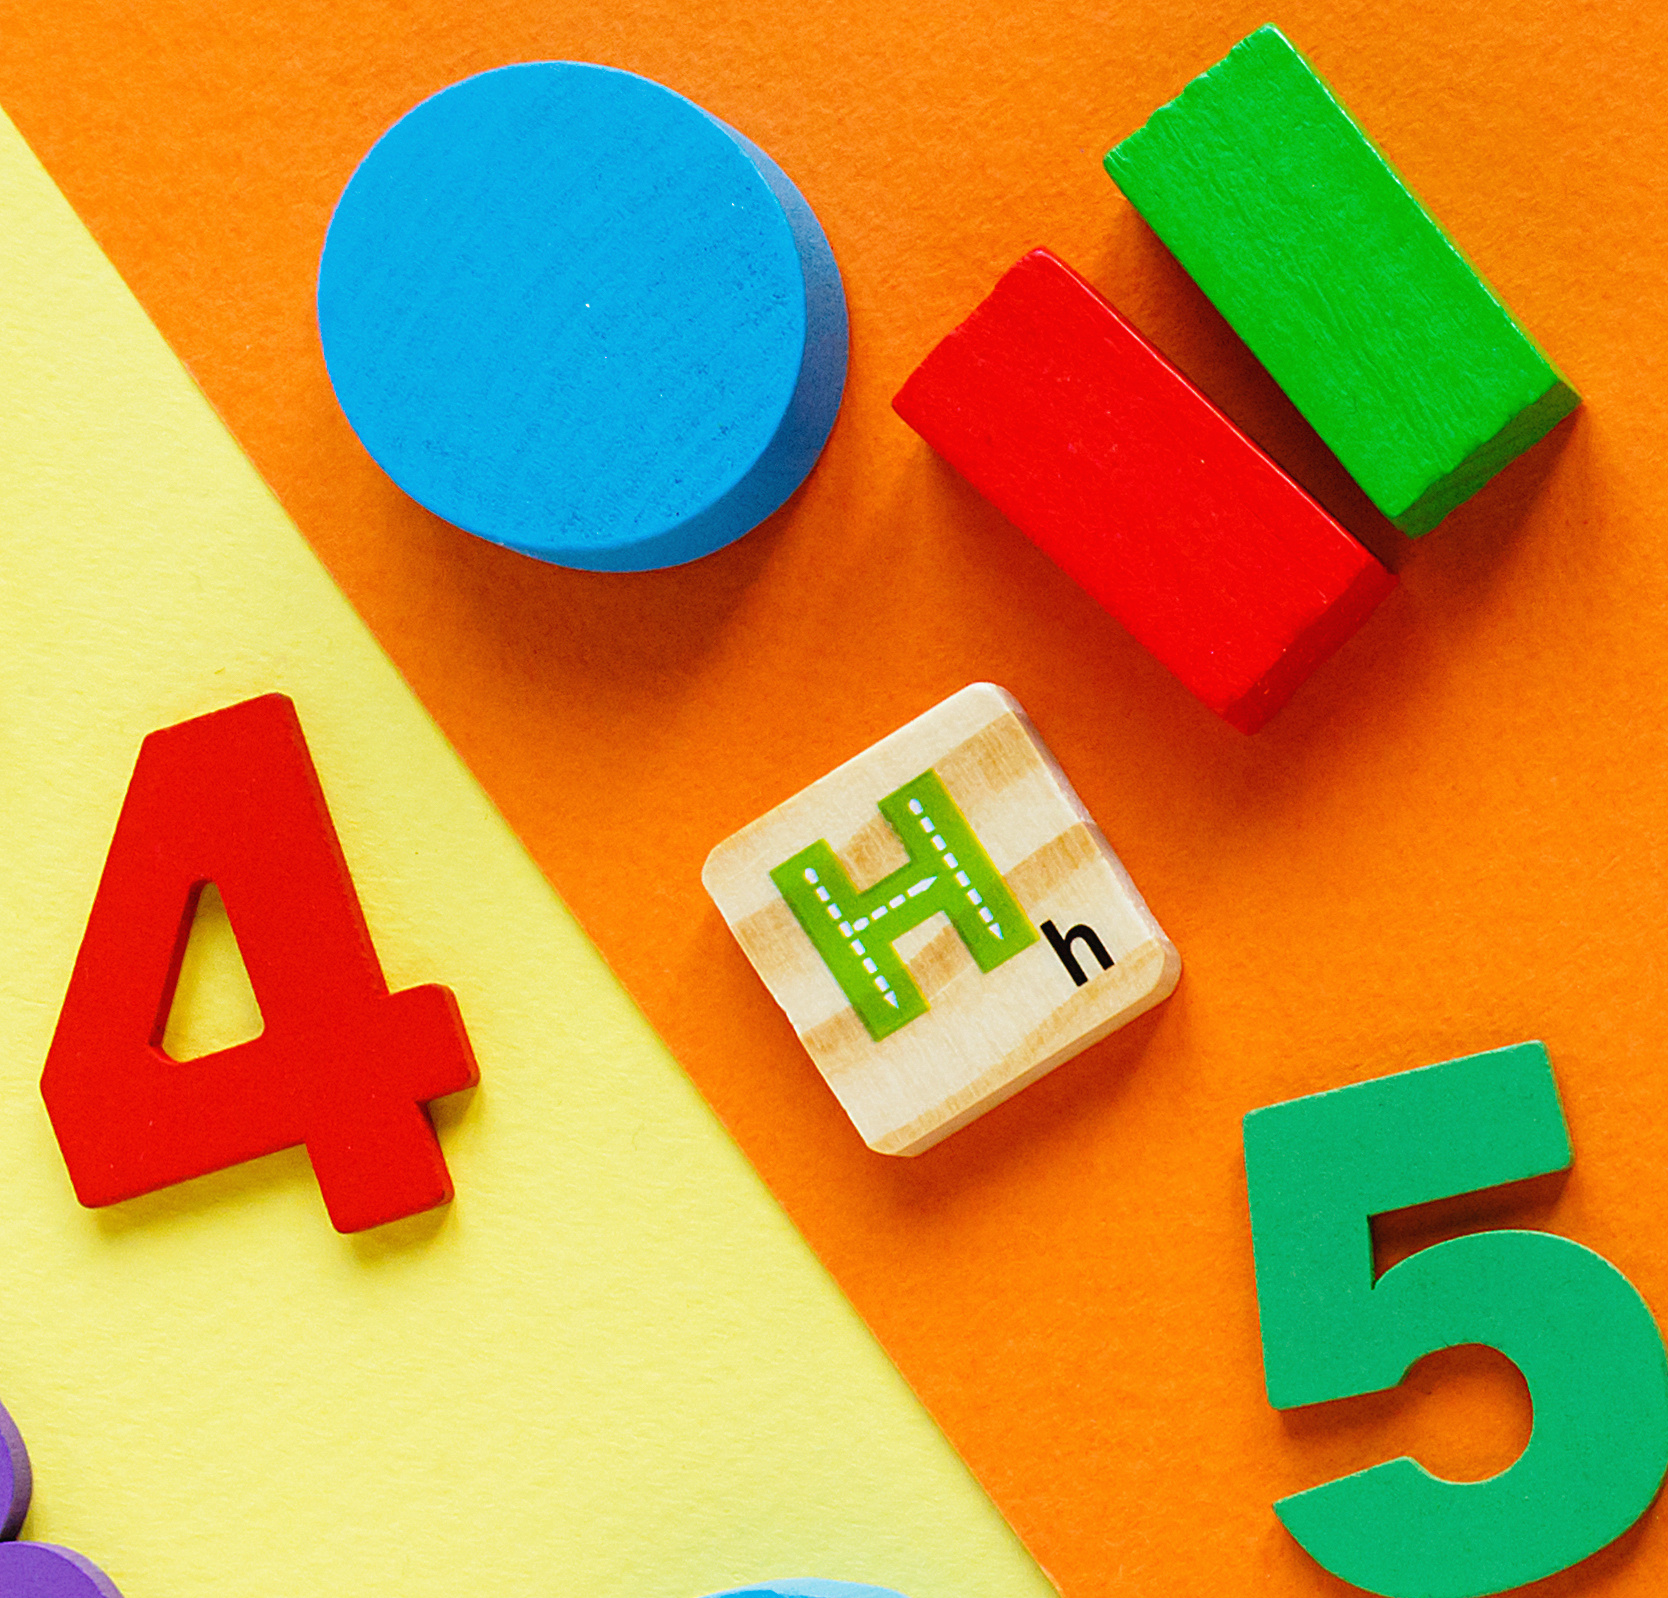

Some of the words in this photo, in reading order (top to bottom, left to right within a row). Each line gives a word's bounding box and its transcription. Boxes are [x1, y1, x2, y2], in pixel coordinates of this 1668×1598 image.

[41, 694, 474, 1233] 4
[770, 770, 1037, 1042] H
[1041, 921, 1114, 986] h
